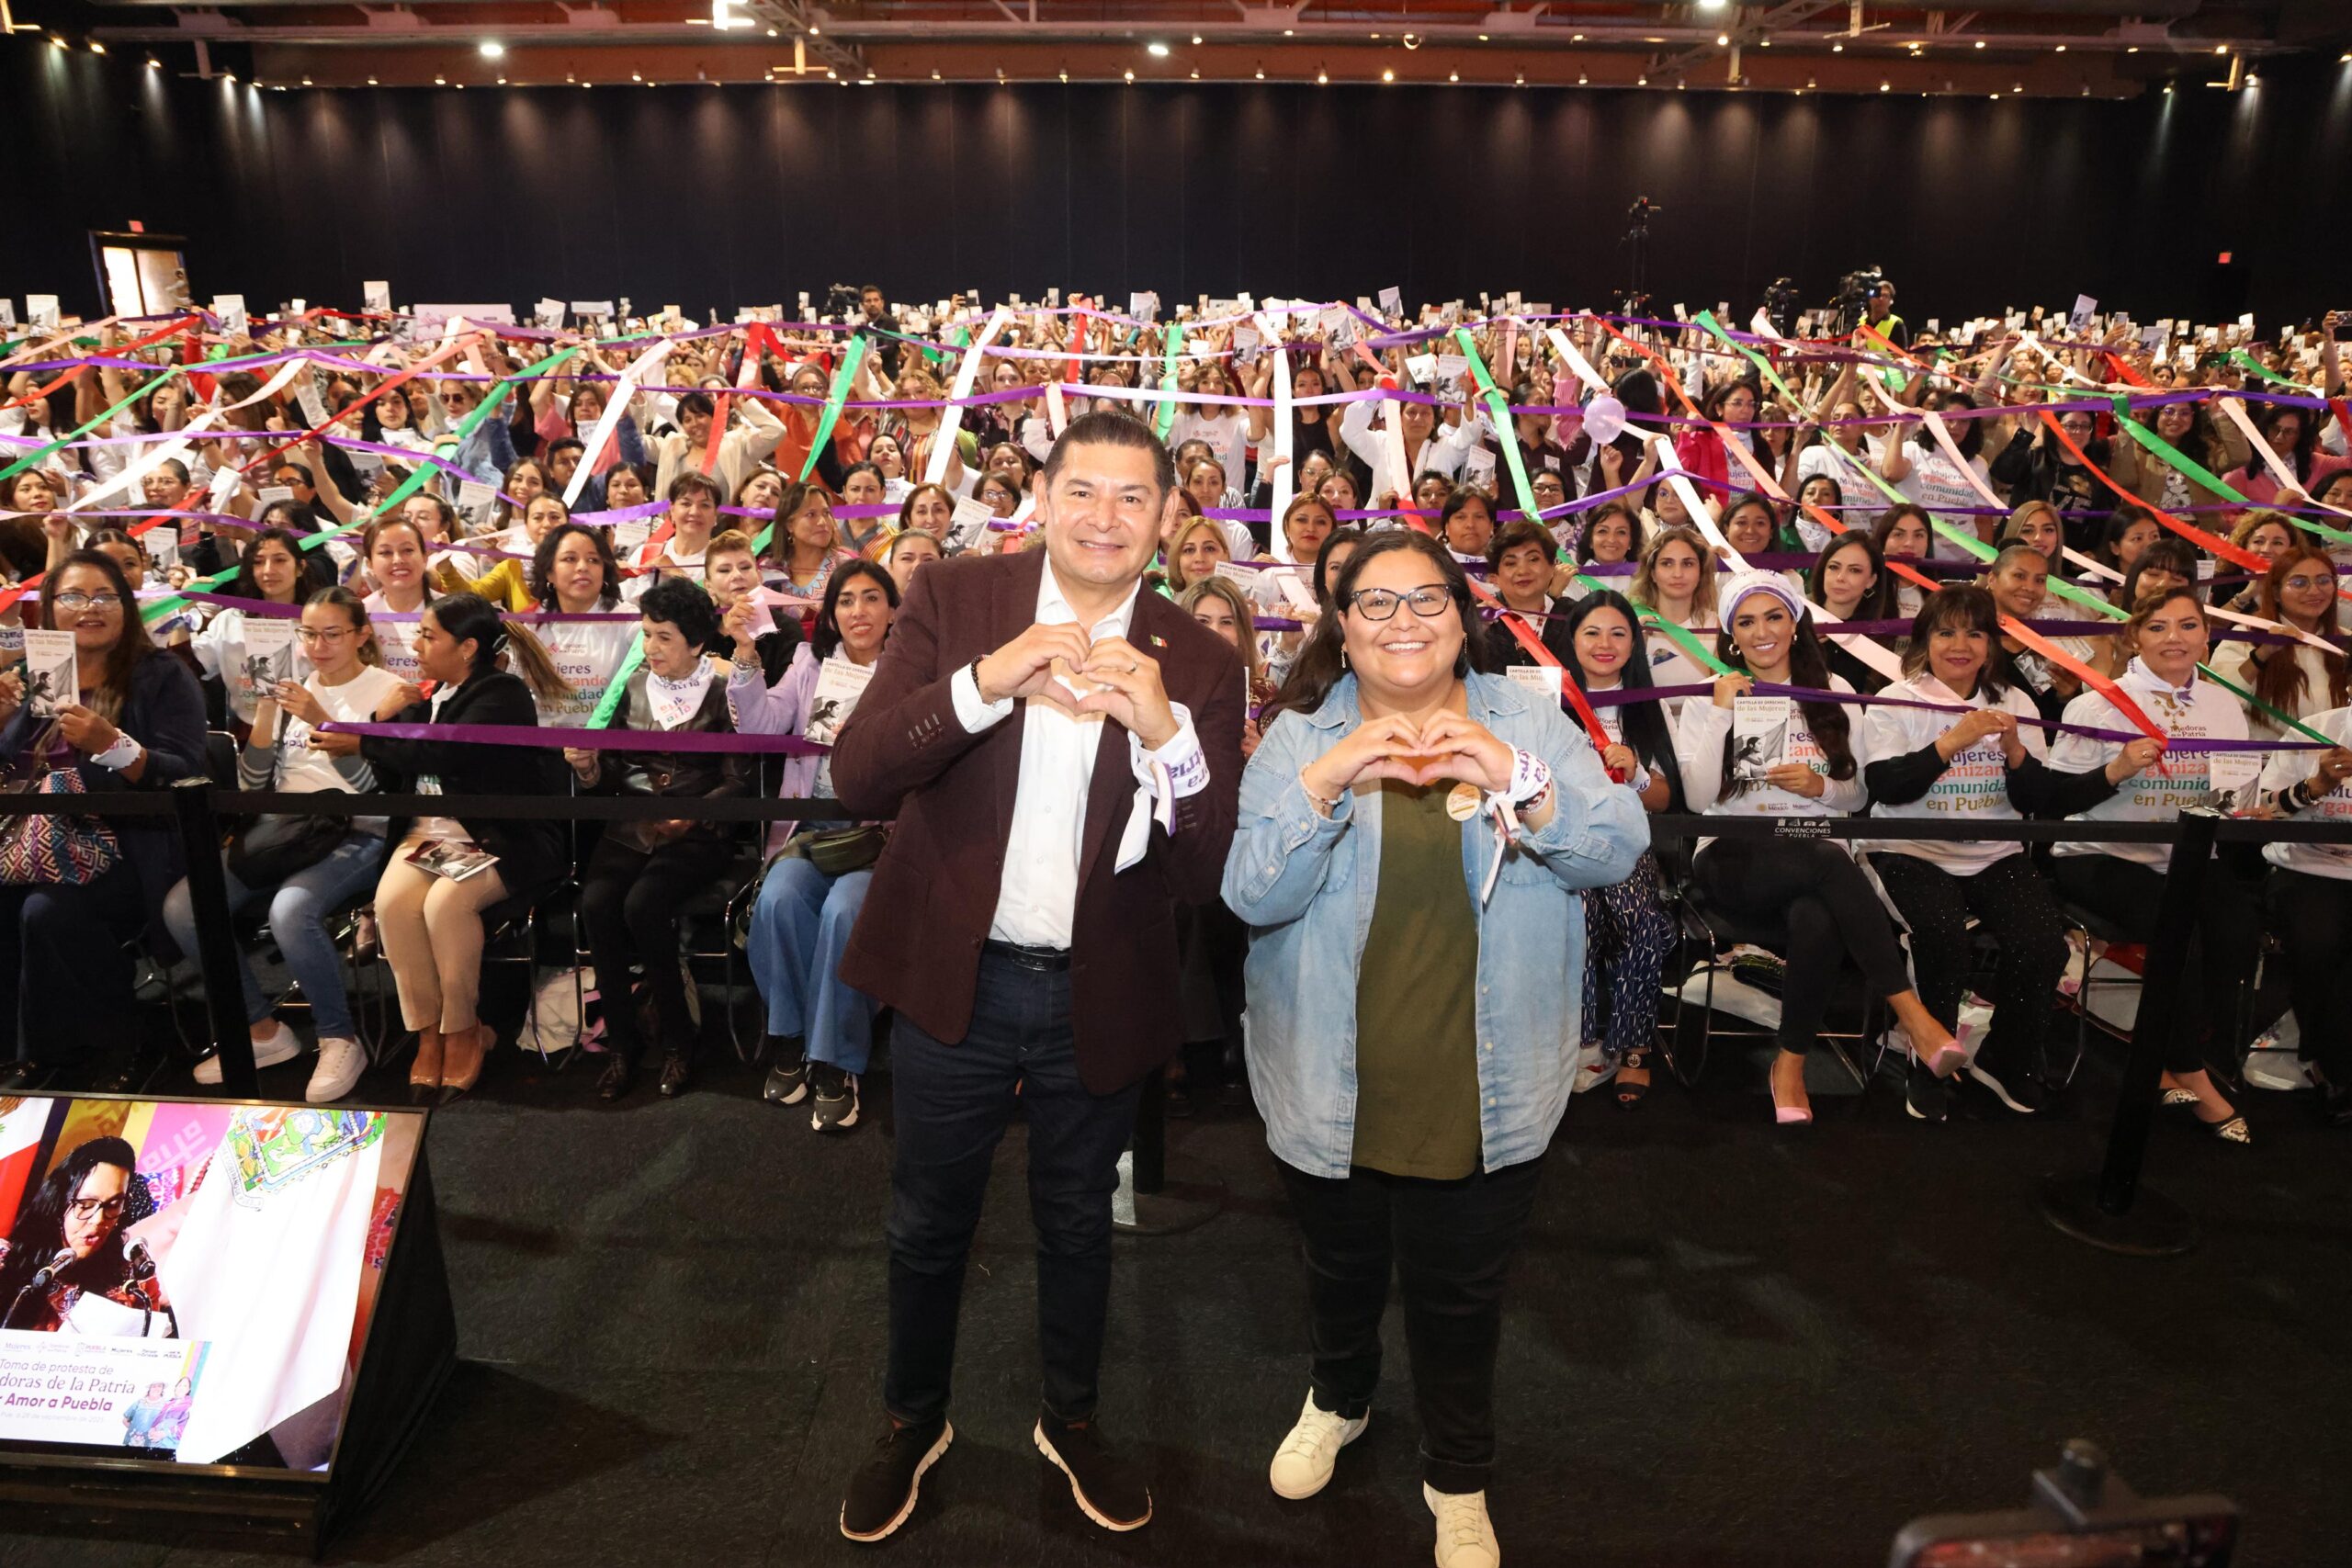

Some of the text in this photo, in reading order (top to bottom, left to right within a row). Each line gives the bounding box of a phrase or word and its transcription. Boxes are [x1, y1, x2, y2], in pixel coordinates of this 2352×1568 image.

[1926, 798, 1949, 811] en
[2133, 795, 2156, 807] en
[0, 1359, 114, 1375] Toma de protesta de
[47, 1375, 66, 1390] de
[70, 1377, 84, 1391] la
[88, 1378, 135, 1393] Patria
[5, 1393, 113, 1411] Amor a Puebla
